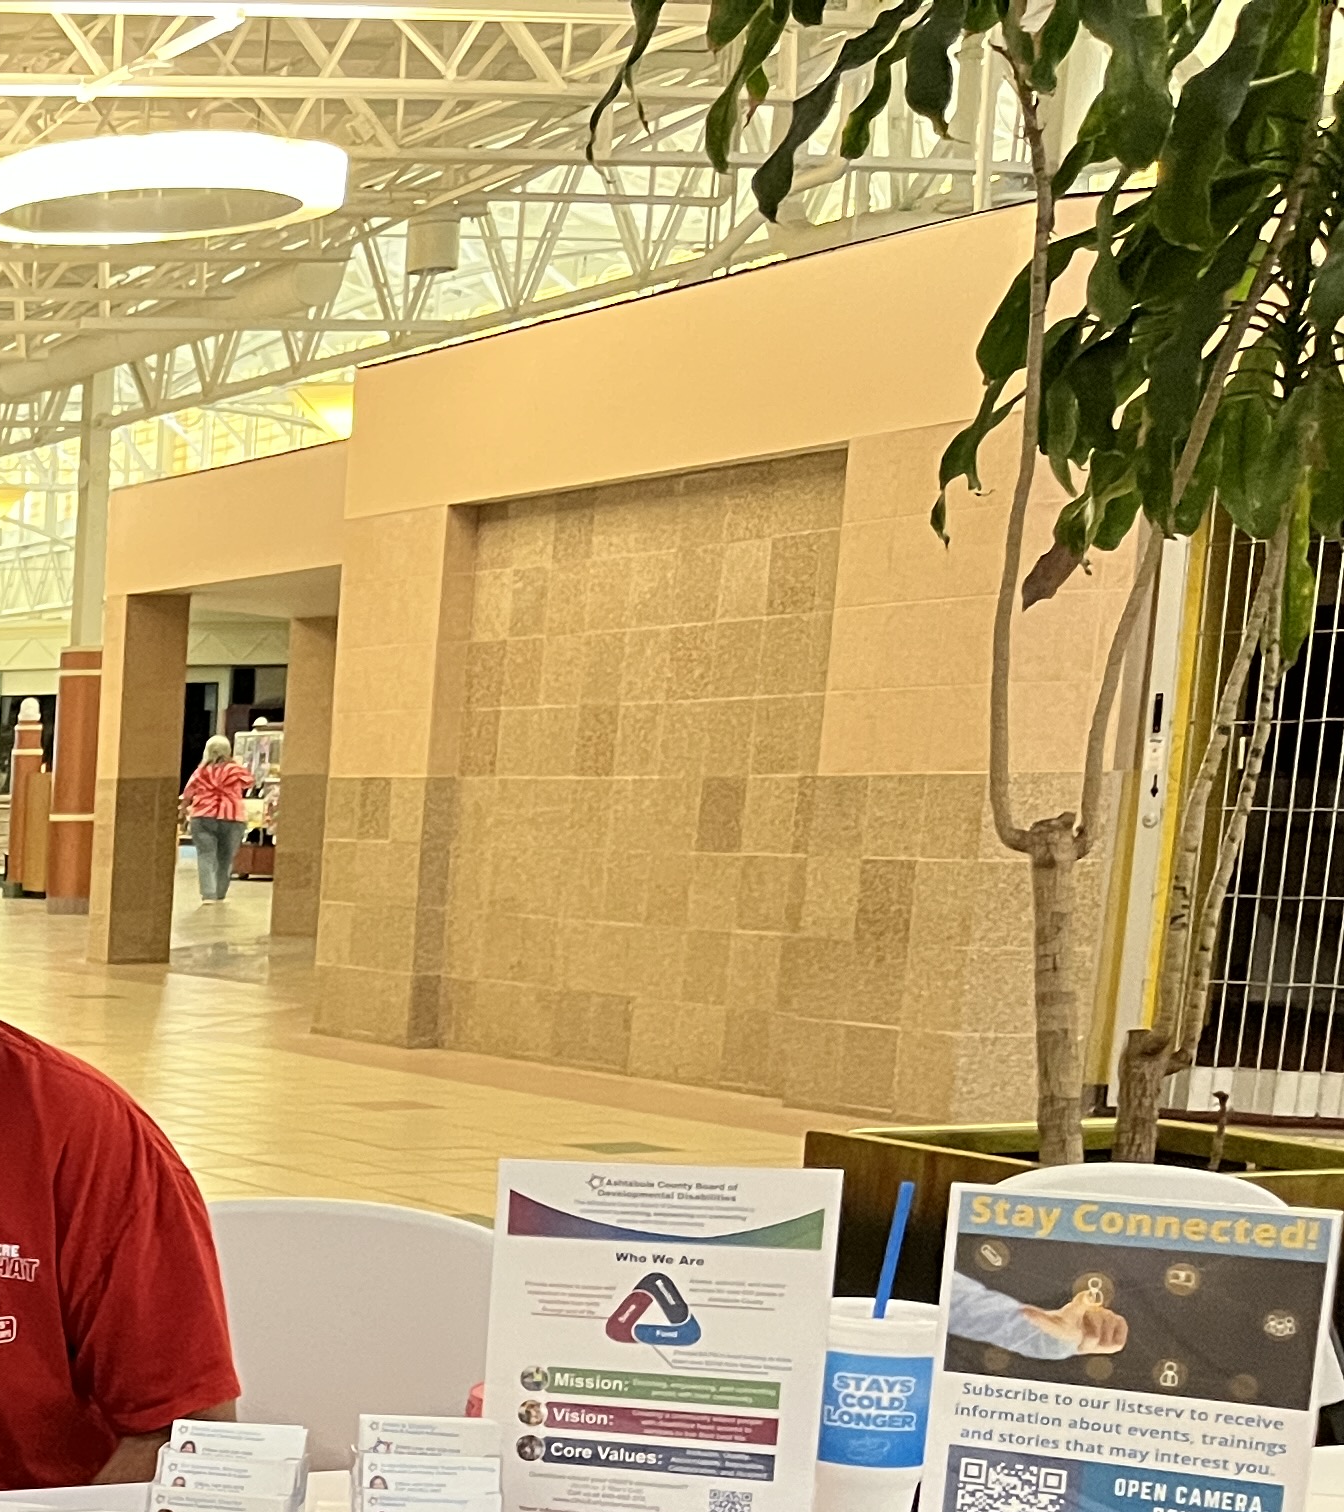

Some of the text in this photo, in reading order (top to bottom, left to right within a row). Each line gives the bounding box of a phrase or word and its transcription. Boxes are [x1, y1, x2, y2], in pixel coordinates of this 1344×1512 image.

[970, 1195, 1322, 1250] Stay Connected!
[615, 1252, 705, 1266] Who We Are
[554, 1372, 629, 1392] Mission:
[835, 1373, 914, 1395] STAYS
[840, 1392, 905, 1411] COLD
[962, 1382, 1285, 1431] Subscribe to our listserv to receive
[552, 1407, 615, 1426] Vision:
[825, 1406, 915, 1429] LONGER
[954, 1402, 1288, 1457] information about events, trainings
[550, 1442, 592, 1459] Core
[597, 1445, 663, 1466] Values:
[960, 1427, 1276, 1478] and stories that may interest you.
[1114, 1478, 1167, 1502] OPEN
